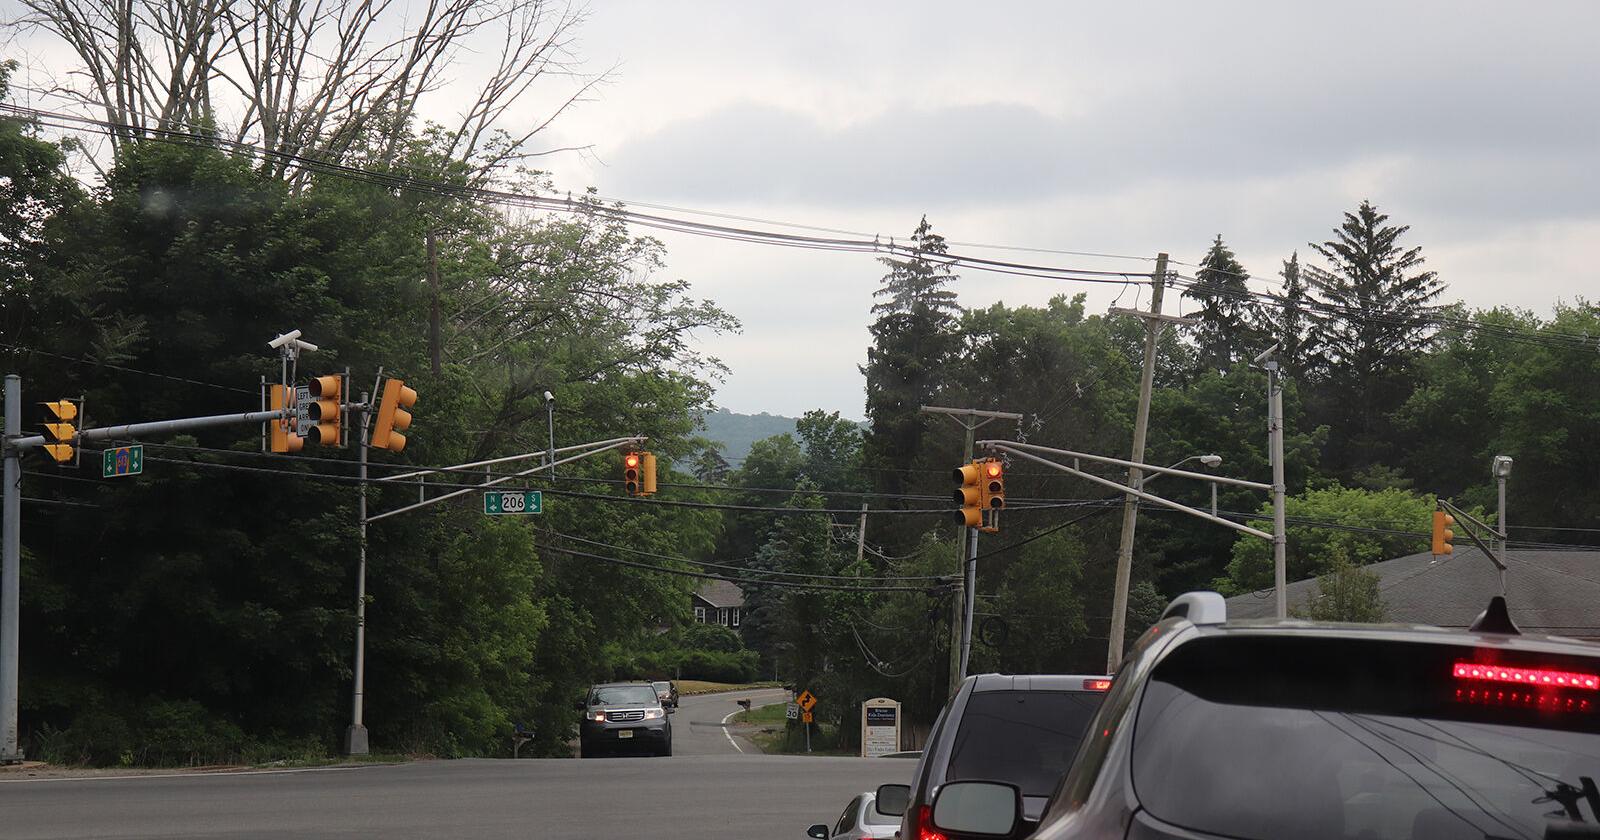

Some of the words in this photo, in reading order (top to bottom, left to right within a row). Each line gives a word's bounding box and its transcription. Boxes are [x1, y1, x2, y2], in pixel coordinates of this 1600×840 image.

[298, 391, 309, 400] LEFT
[490, 495, 496, 503] N
[503, 497, 524, 509] 206
[531, 494, 536, 502] S
[787, 710, 798, 718] 30
